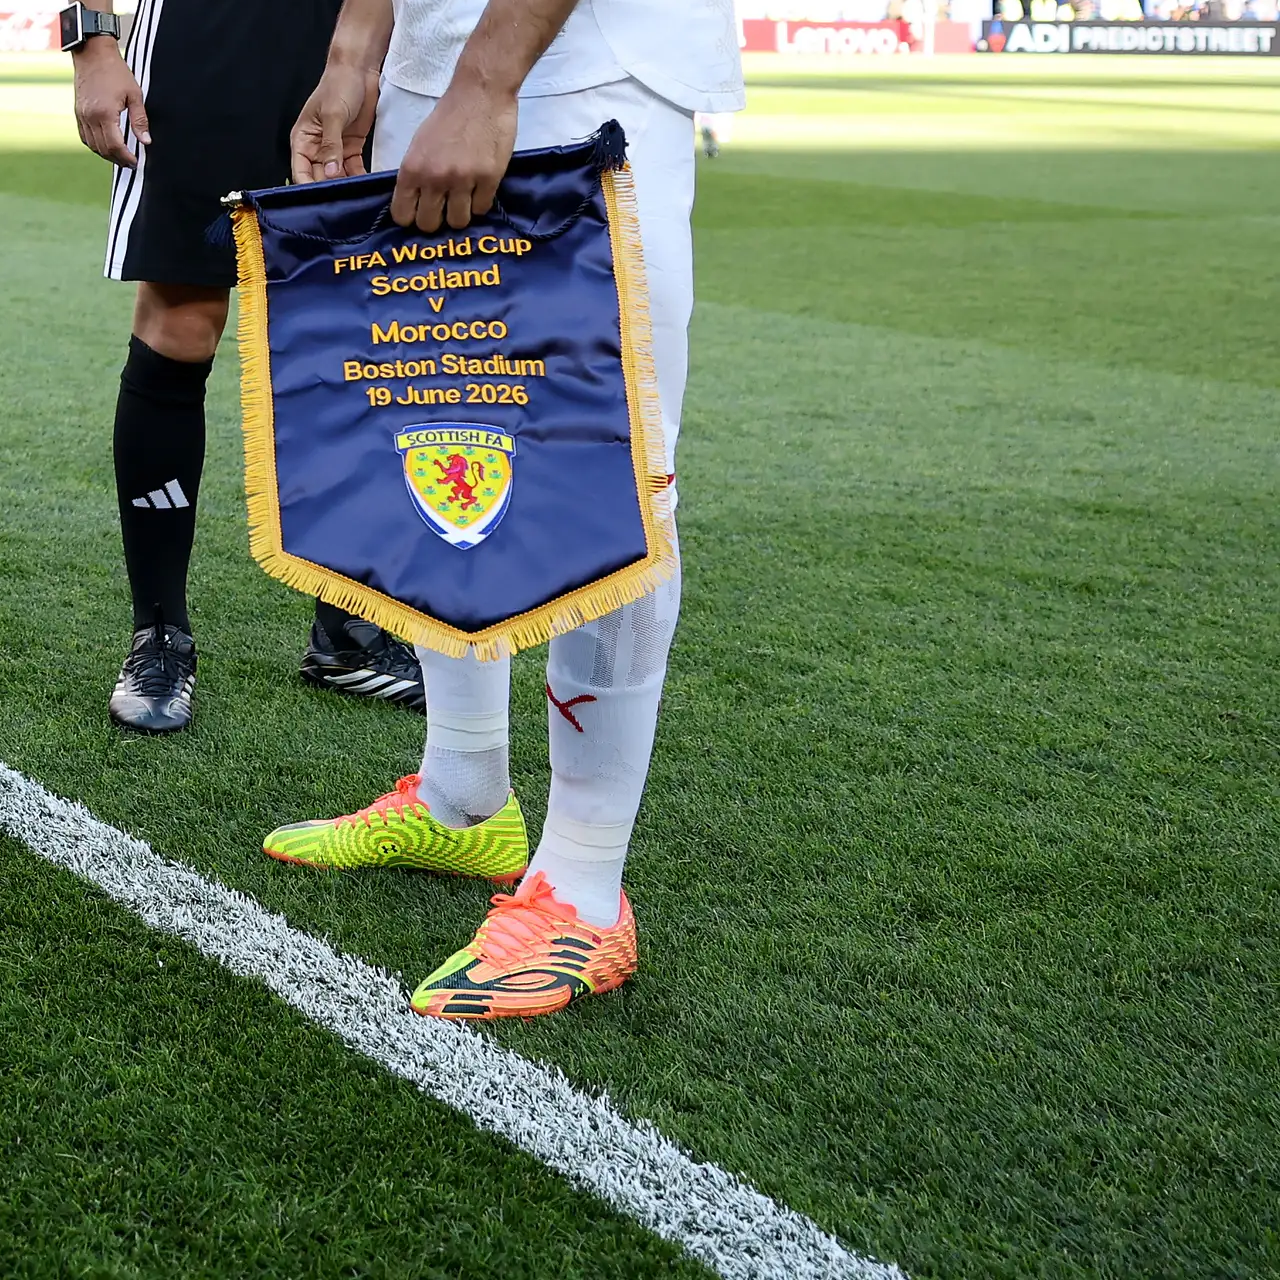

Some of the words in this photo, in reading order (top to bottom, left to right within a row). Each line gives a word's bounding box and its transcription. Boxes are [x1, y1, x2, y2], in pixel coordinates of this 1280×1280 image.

[1006, 23, 1070, 52] ADI
[1073, 27, 1276, 52] PREDICTSTREET
[334, 251, 387, 274] FIFA
[392, 237, 471, 263] World
[478, 235, 532, 255] Cup
[371, 264, 501, 296] Scotland
[428, 297, 445, 313] v
[371, 320, 508, 345] Morocco
[343, 359, 436, 381] Boston
[441, 353, 545, 377] Stadium
[366, 386, 392, 406] 19
[396, 385, 461, 405] June
[465, 383, 529, 406] 2026
[406, 430, 480, 446] SCOTTISH
[485, 433, 503, 447] FA
